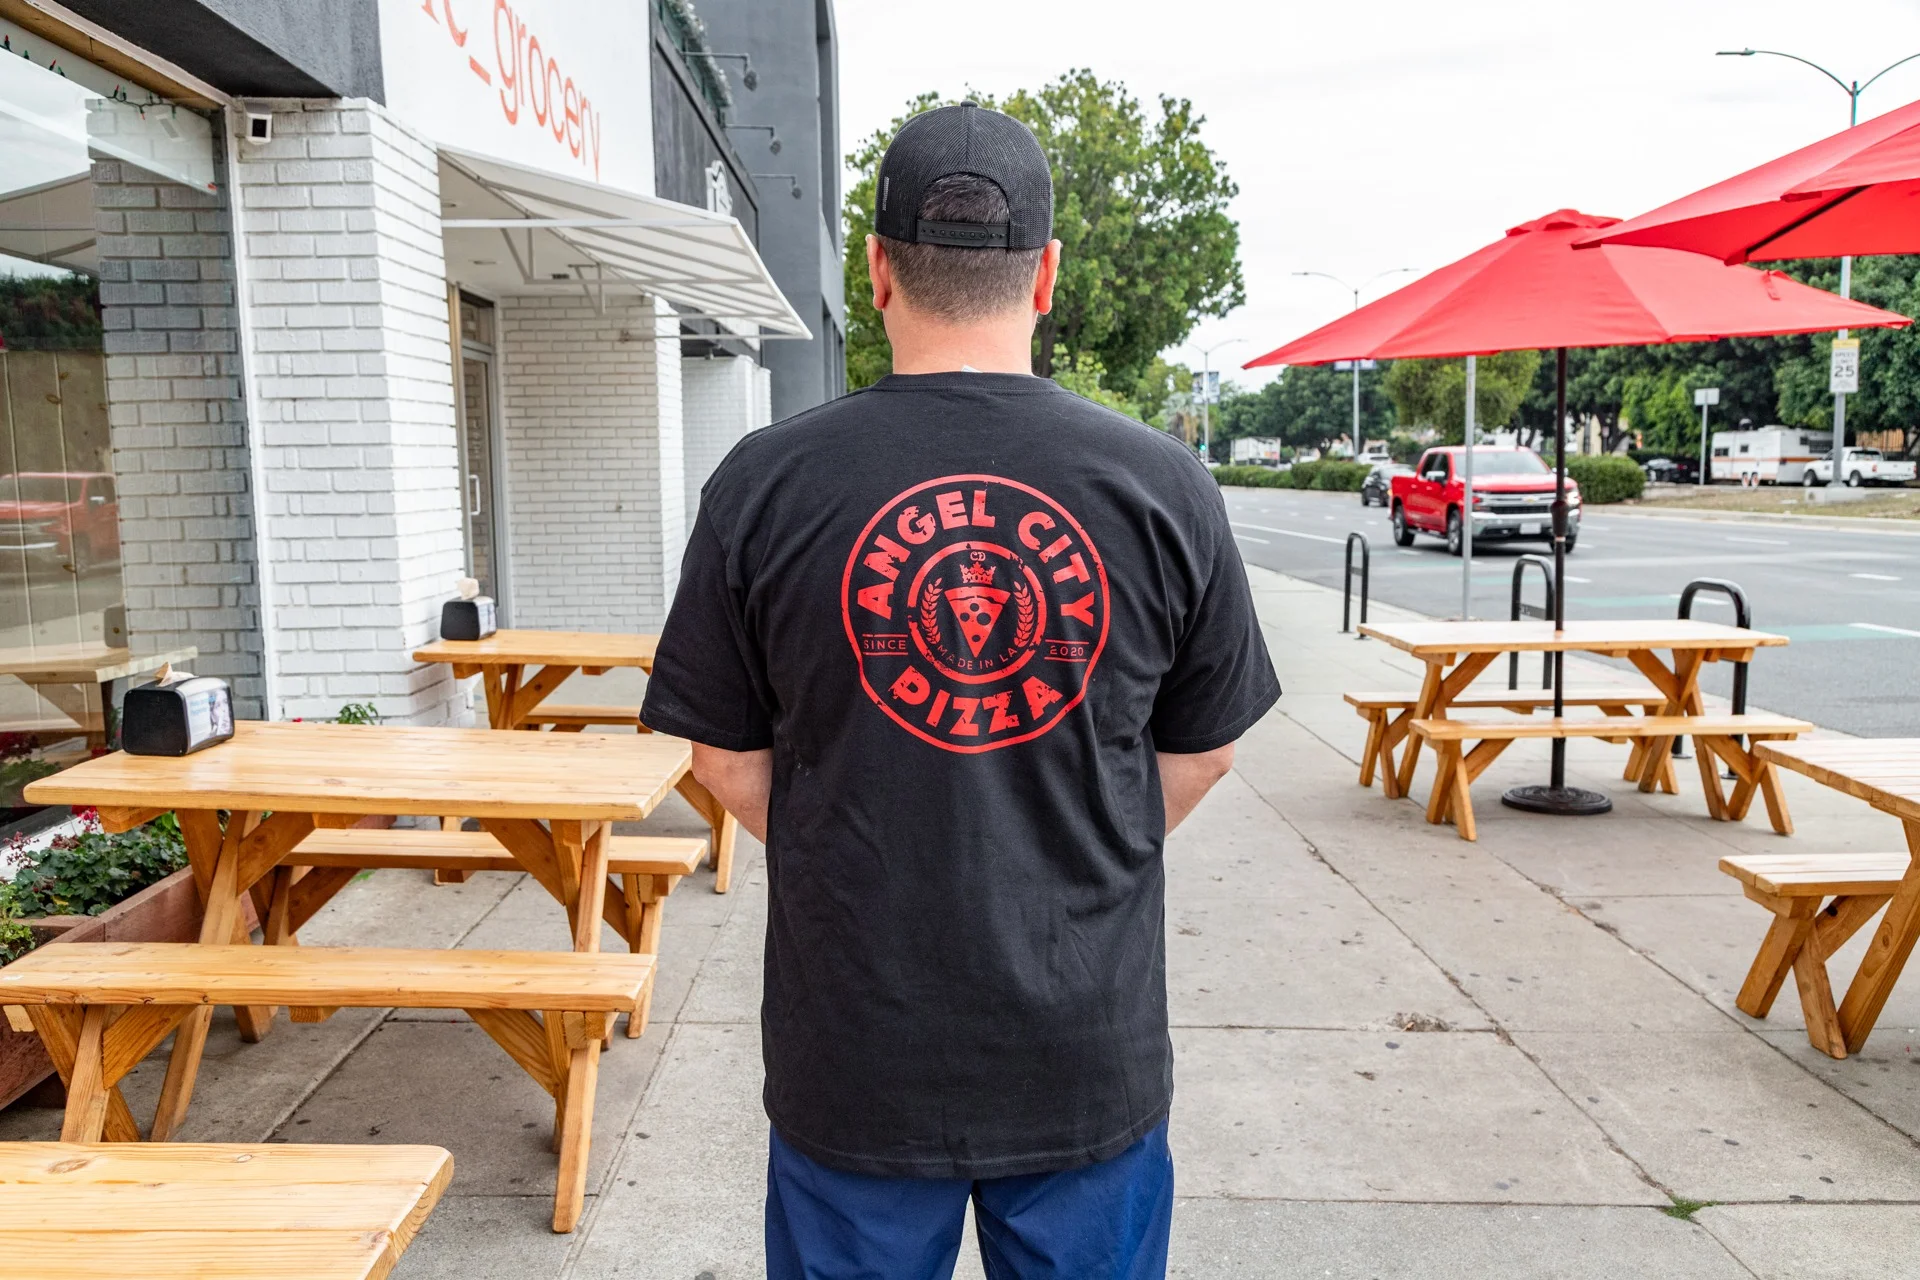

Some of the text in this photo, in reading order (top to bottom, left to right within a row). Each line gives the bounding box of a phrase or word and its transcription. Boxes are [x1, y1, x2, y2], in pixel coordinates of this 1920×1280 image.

[1834, 365, 1855, 377] 25
[857, 490, 1095, 627] ANGEL CITY
[863, 639, 907, 650] SINCE
[1050, 645, 1084, 657] 2020
[937, 645, 1018, 670] MADE IN LA
[888, 665, 1063, 736] PIZZA
